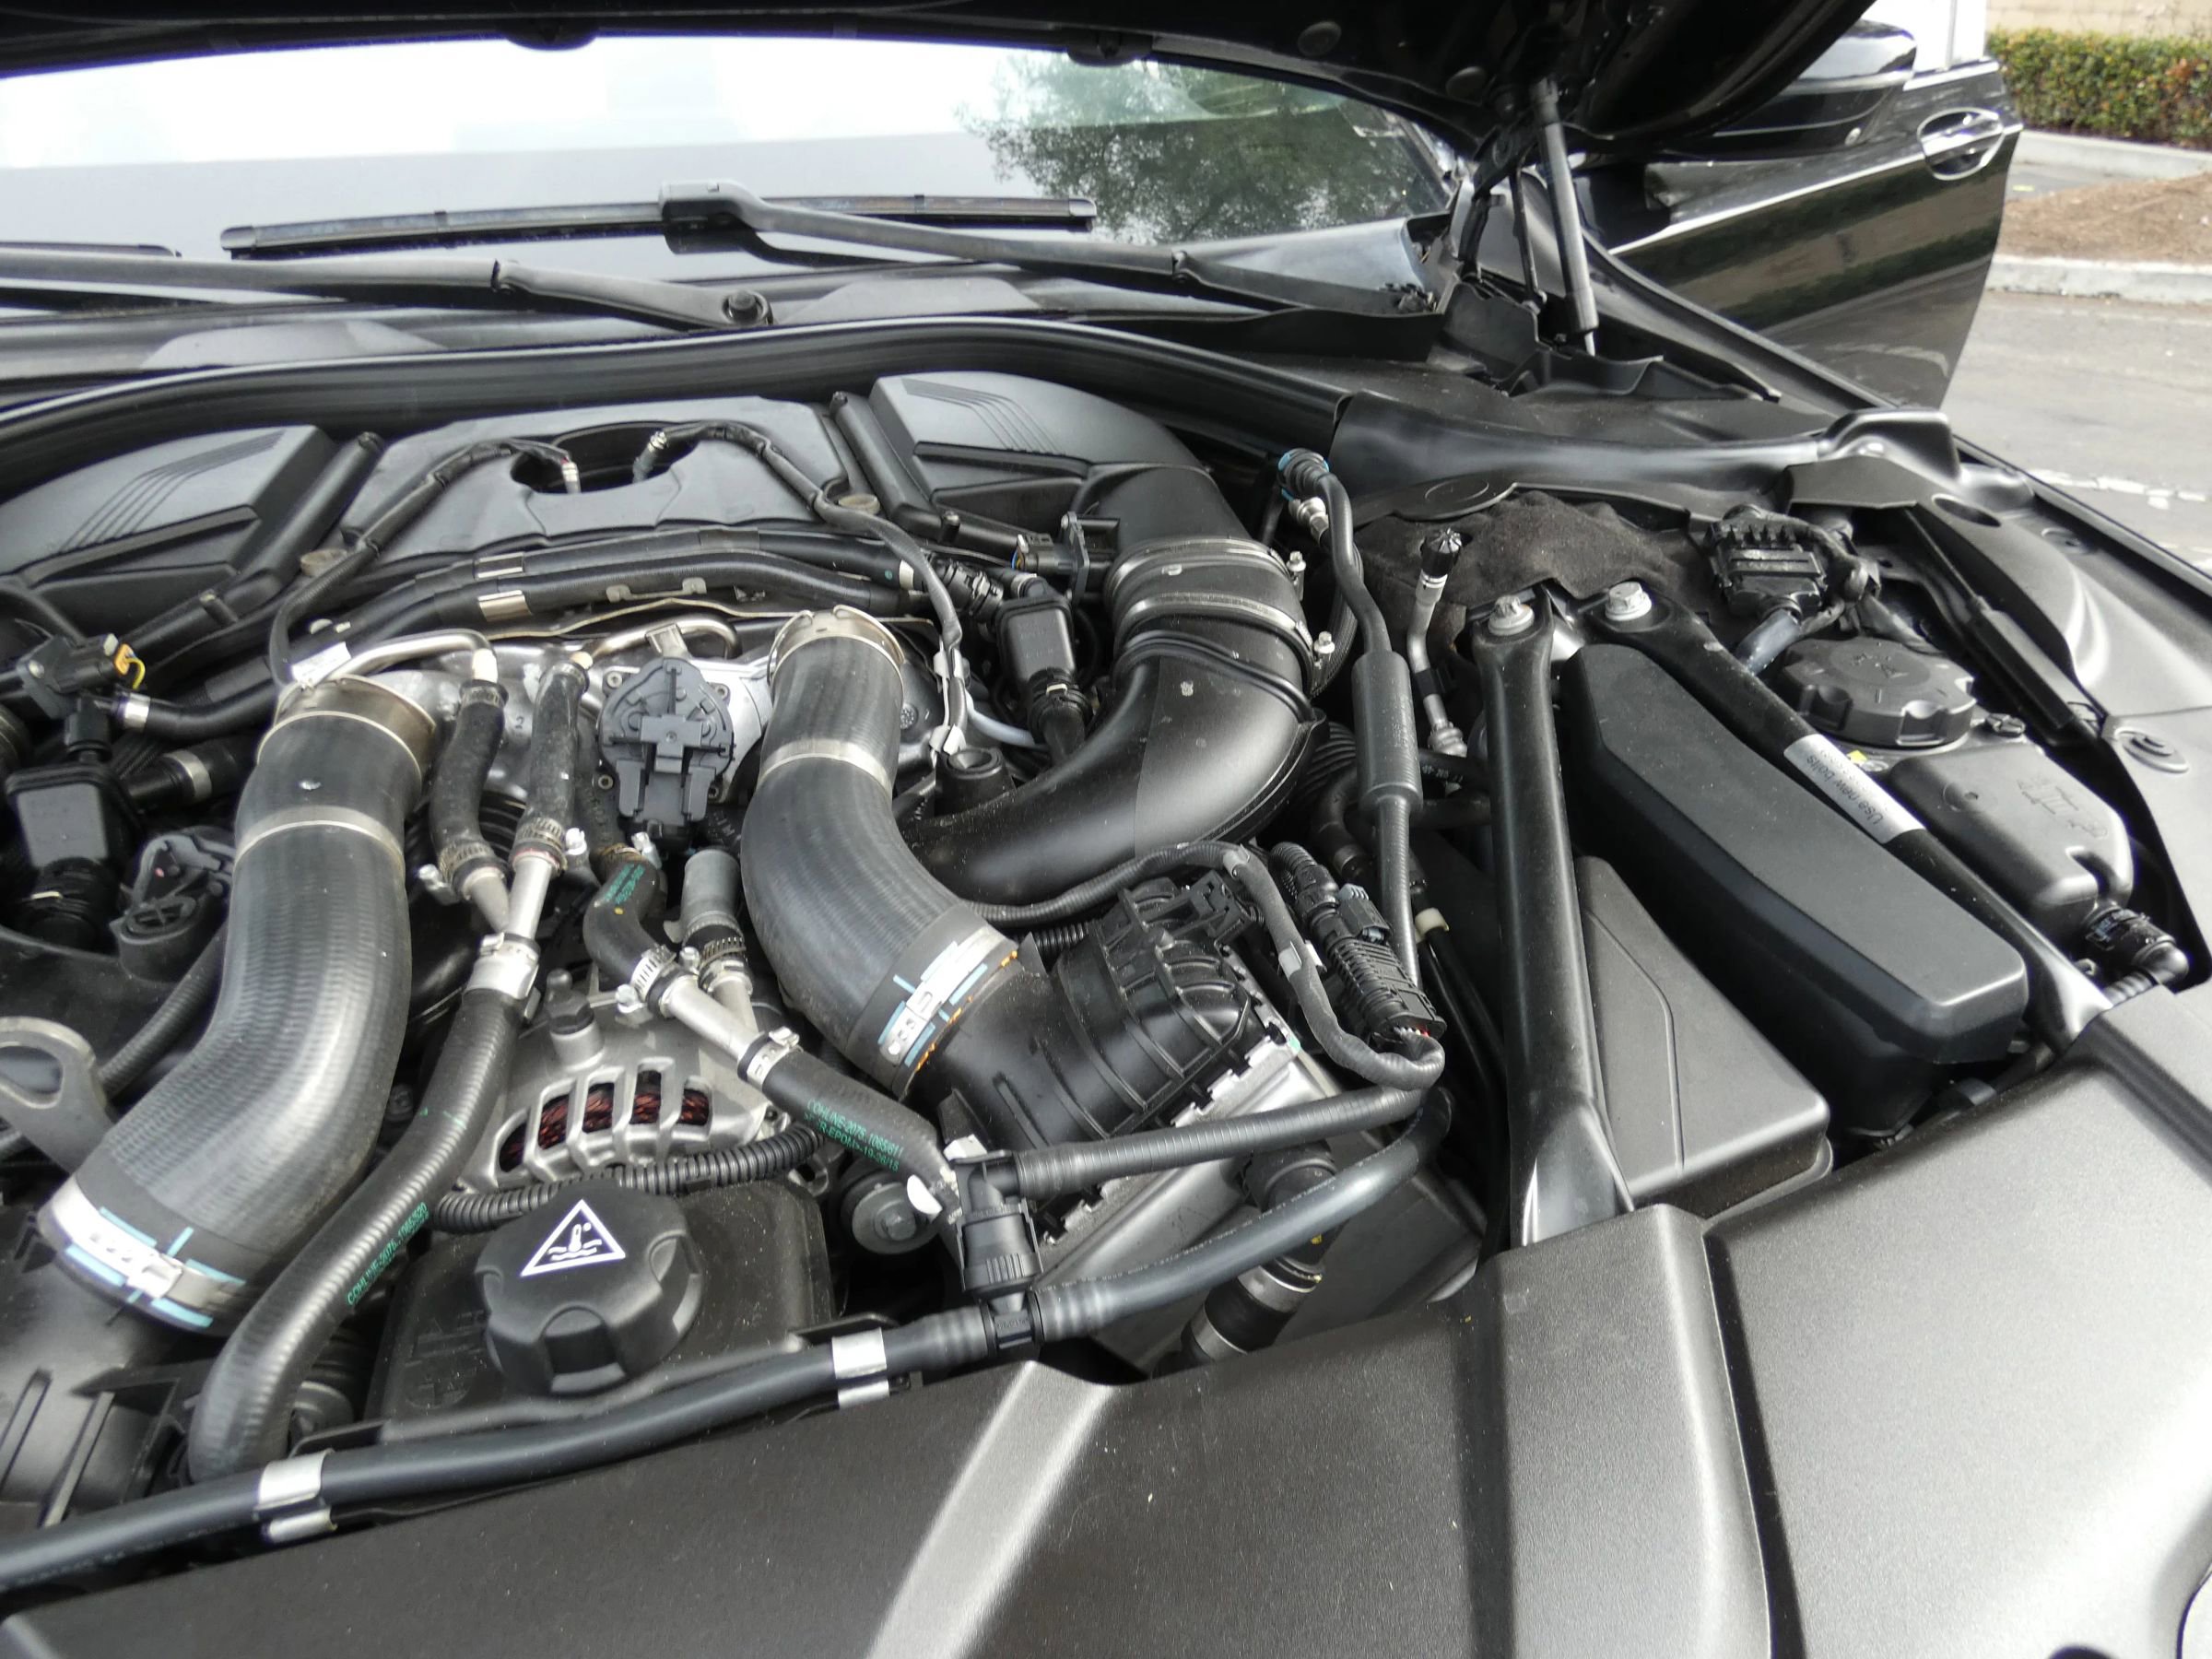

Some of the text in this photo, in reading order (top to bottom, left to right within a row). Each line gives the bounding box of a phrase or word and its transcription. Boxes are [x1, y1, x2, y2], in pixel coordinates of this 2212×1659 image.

[1806, 756, 1835, 782] bolts
[1833, 780, 1859, 801] new
[1858, 801, 1883, 825] Use
